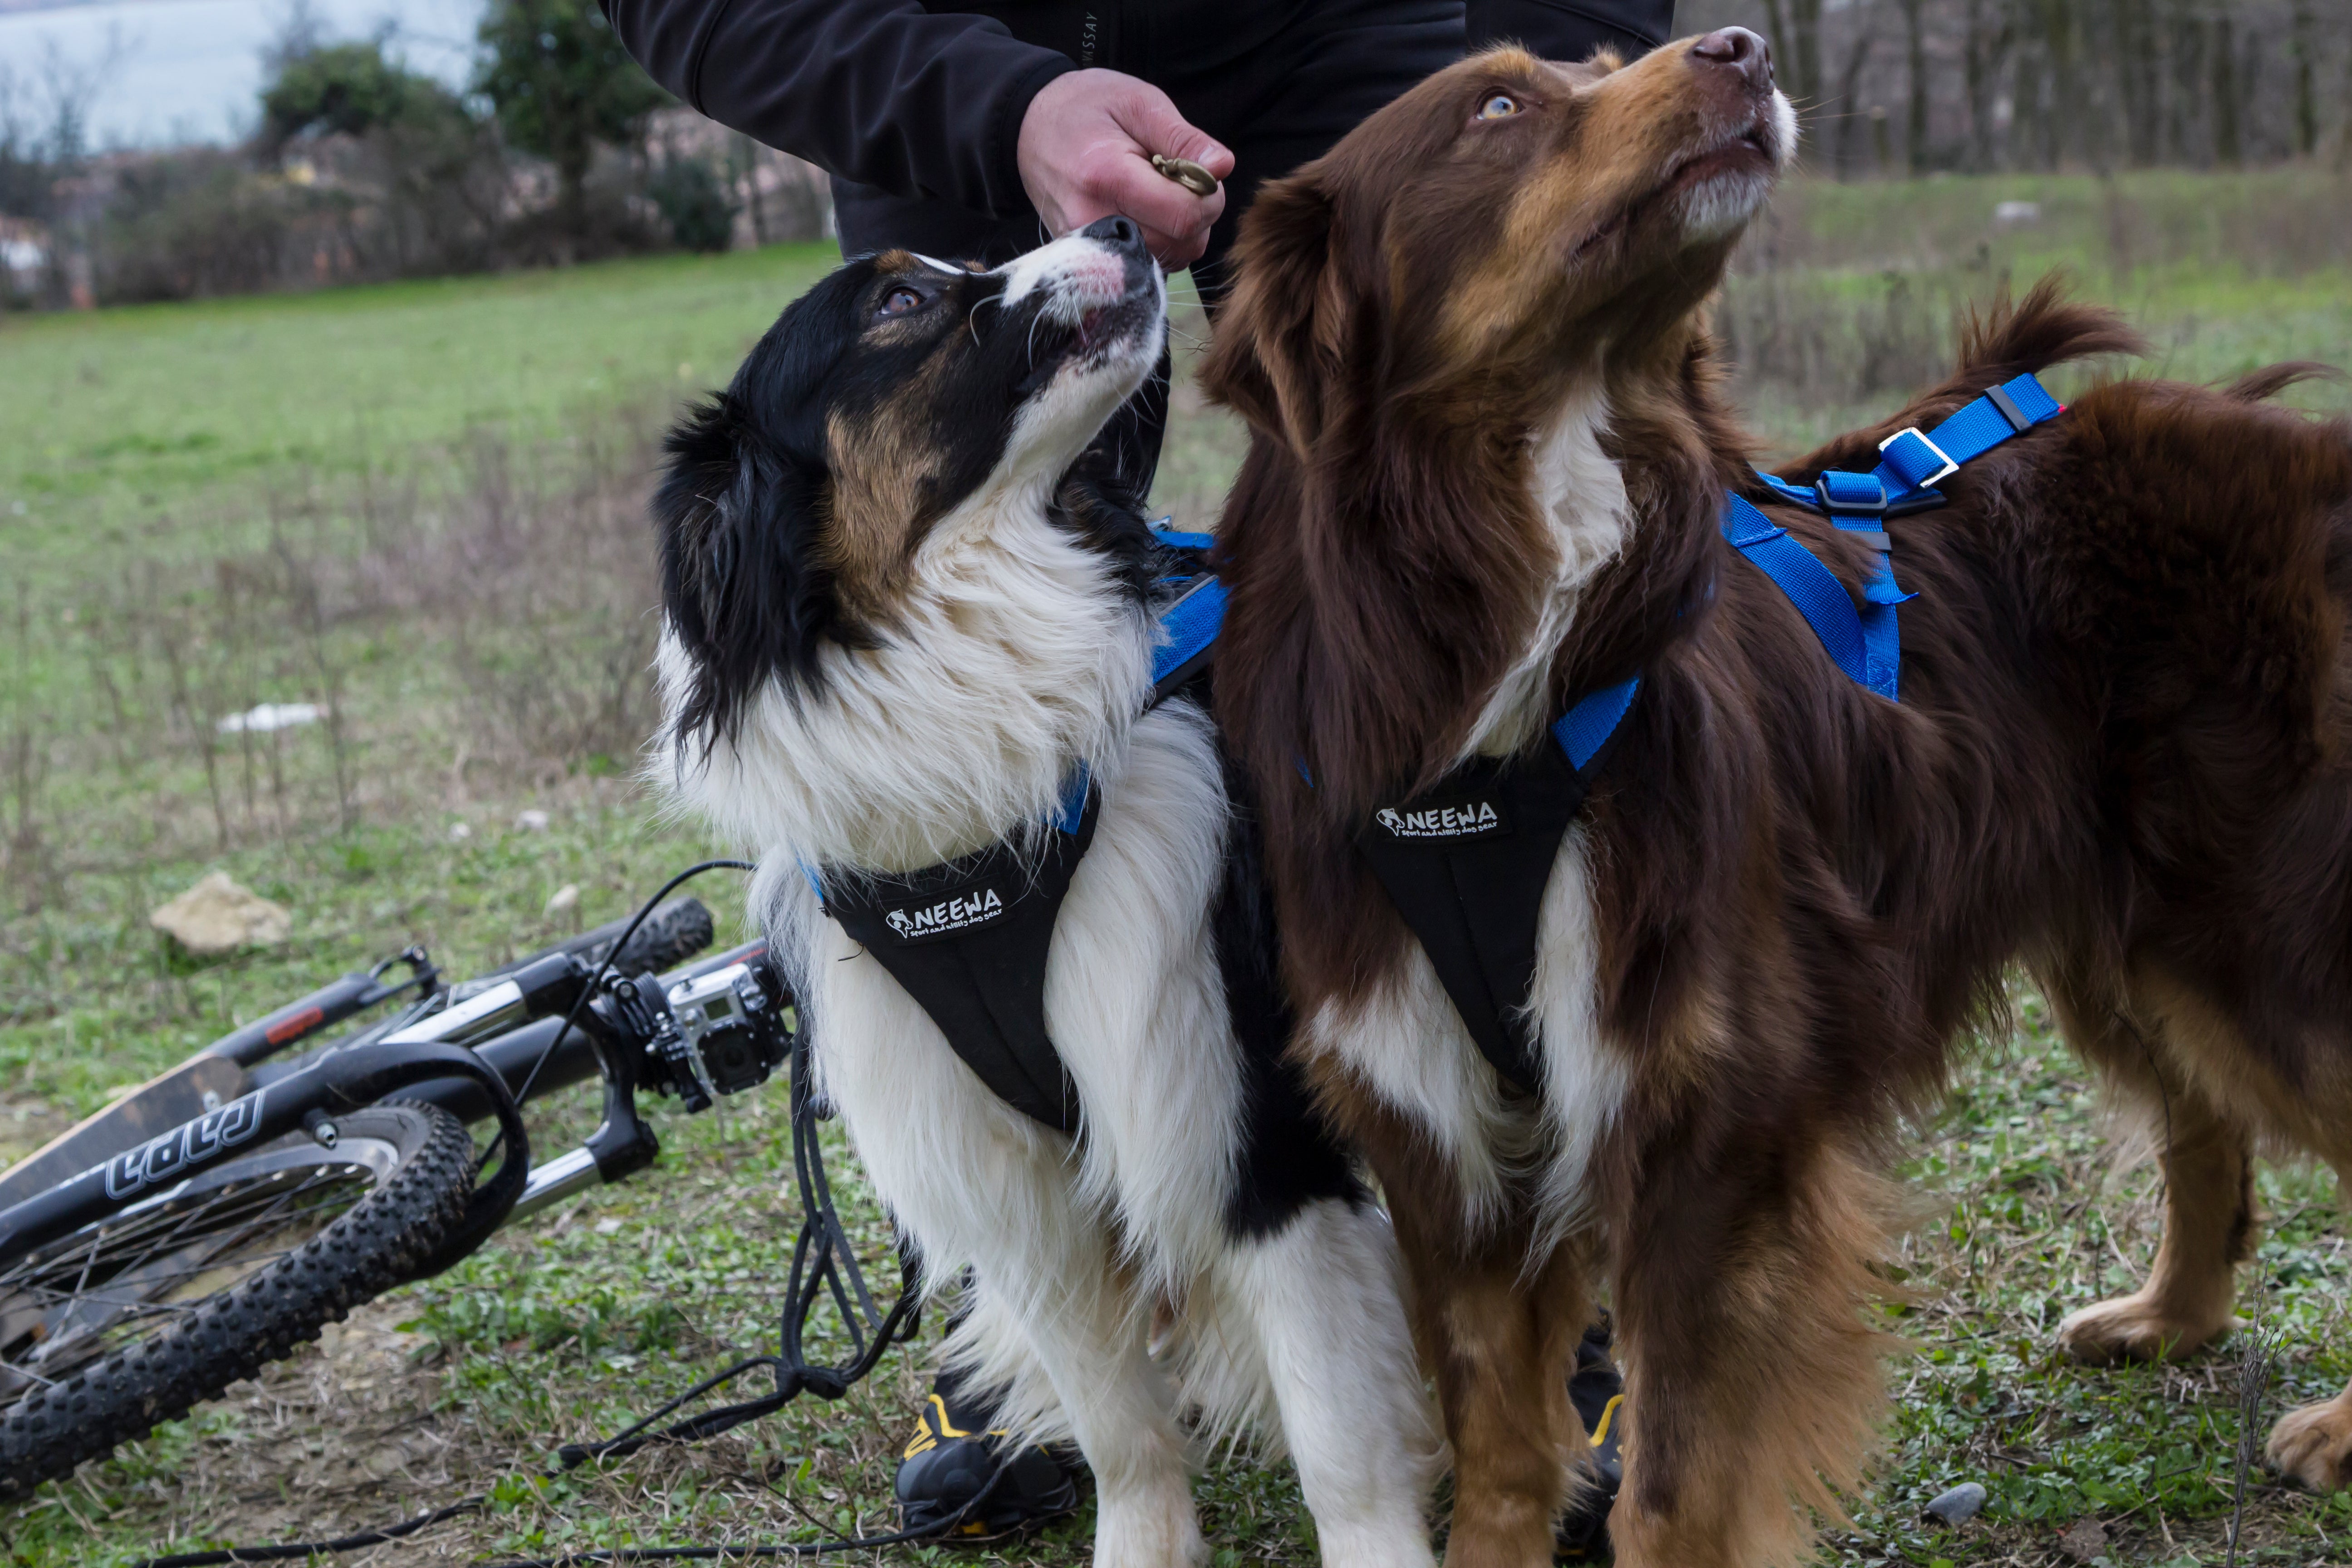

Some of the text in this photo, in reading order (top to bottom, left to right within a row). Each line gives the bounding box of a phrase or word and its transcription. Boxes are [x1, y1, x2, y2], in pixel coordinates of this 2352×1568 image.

[1406, 802, 1497, 829] NEEWA
[1462, 825, 1477, 833] dog
[1478, 821, 1498, 830] gear
[910, 908, 1002, 937] sport and utility dog gear
[915, 889, 1002, 929] NEEWA
